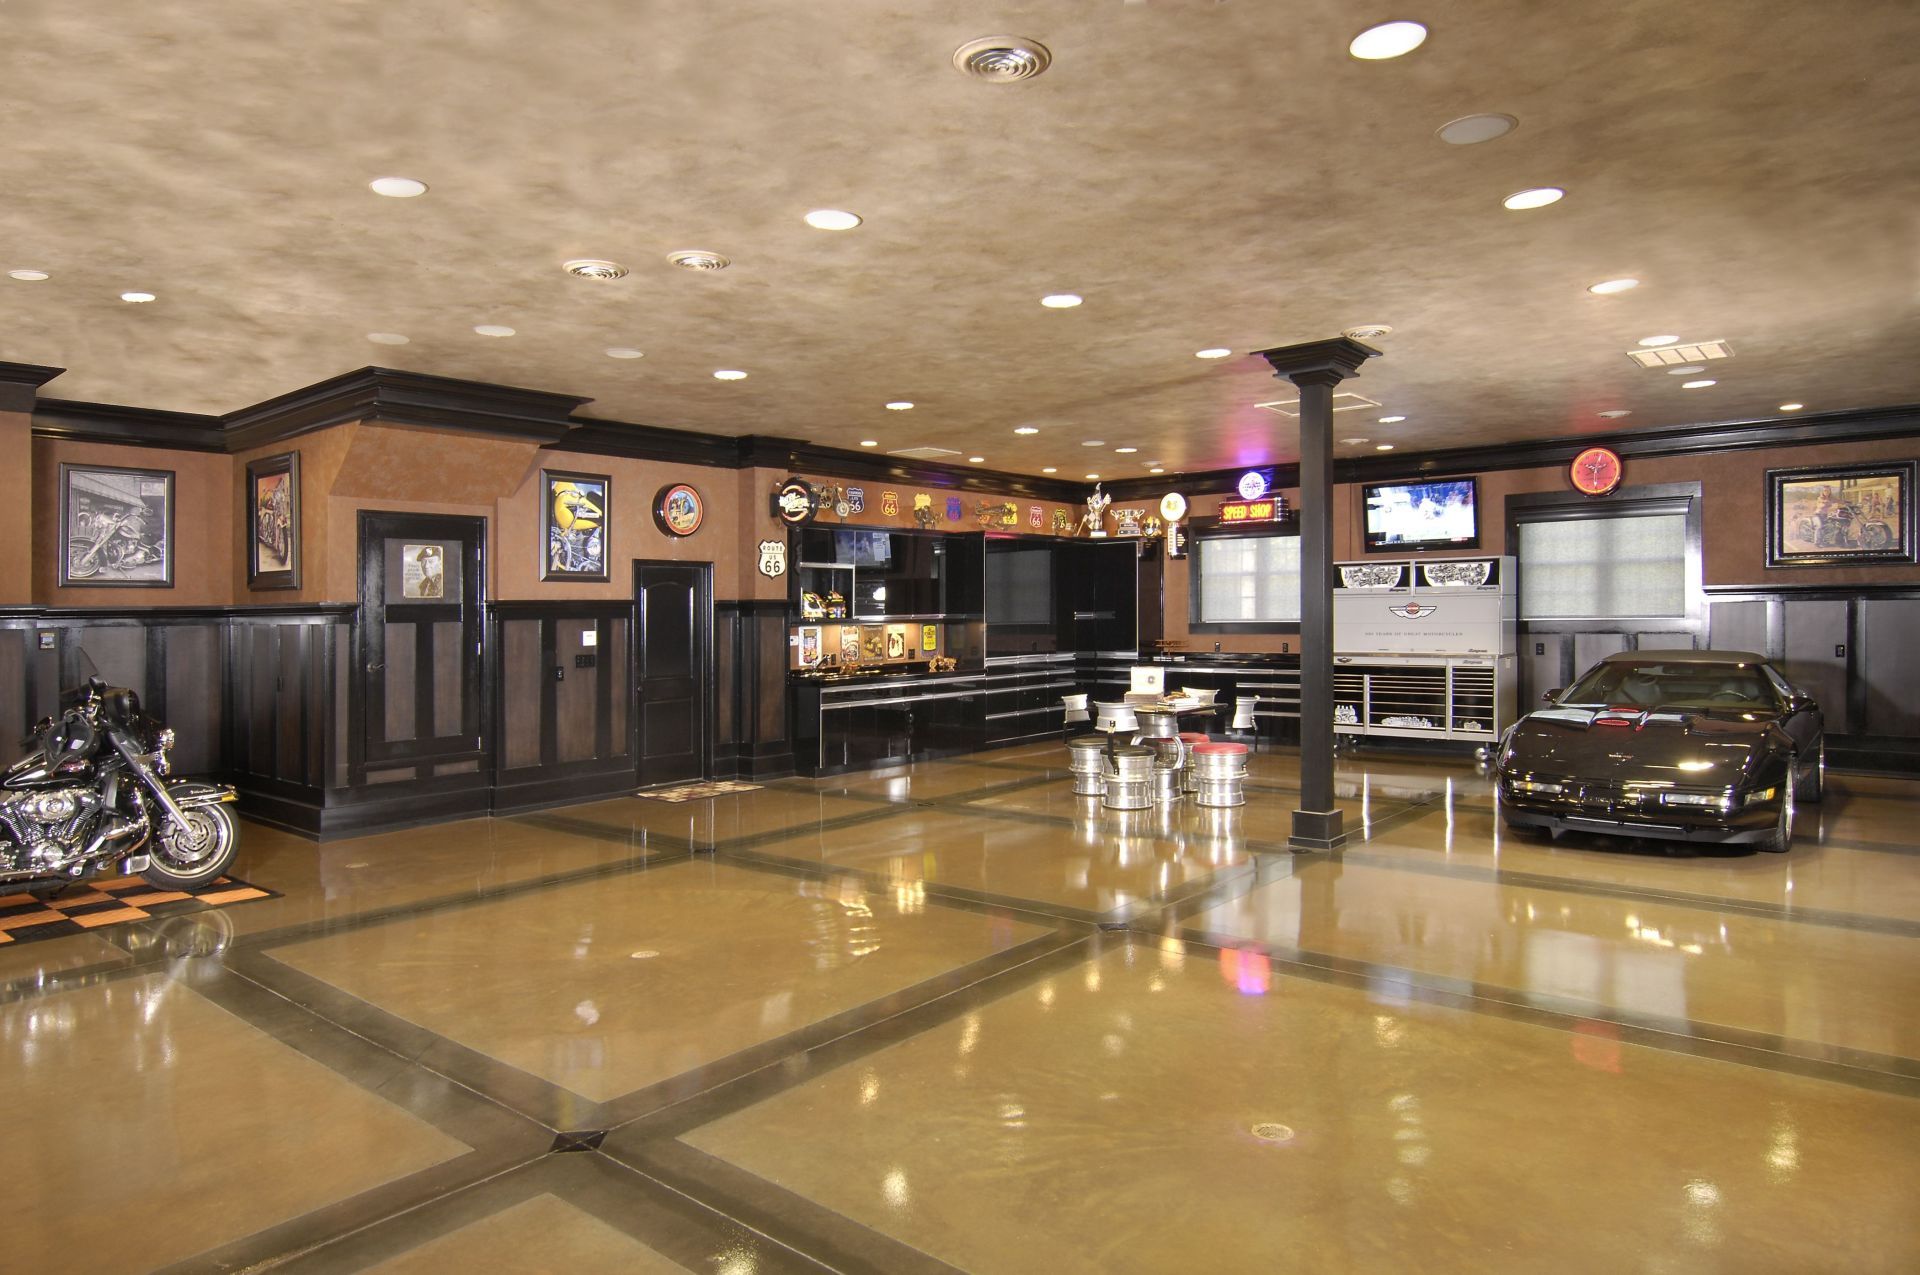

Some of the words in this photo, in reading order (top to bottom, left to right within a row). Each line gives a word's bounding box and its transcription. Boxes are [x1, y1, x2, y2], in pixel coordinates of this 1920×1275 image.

[884, 503, 896, 514] 66
[1223, 505, 1247, 520] SPEED
[1250, 503, 1272, 518] SHOP
[765, 560, 781, 573] 66
